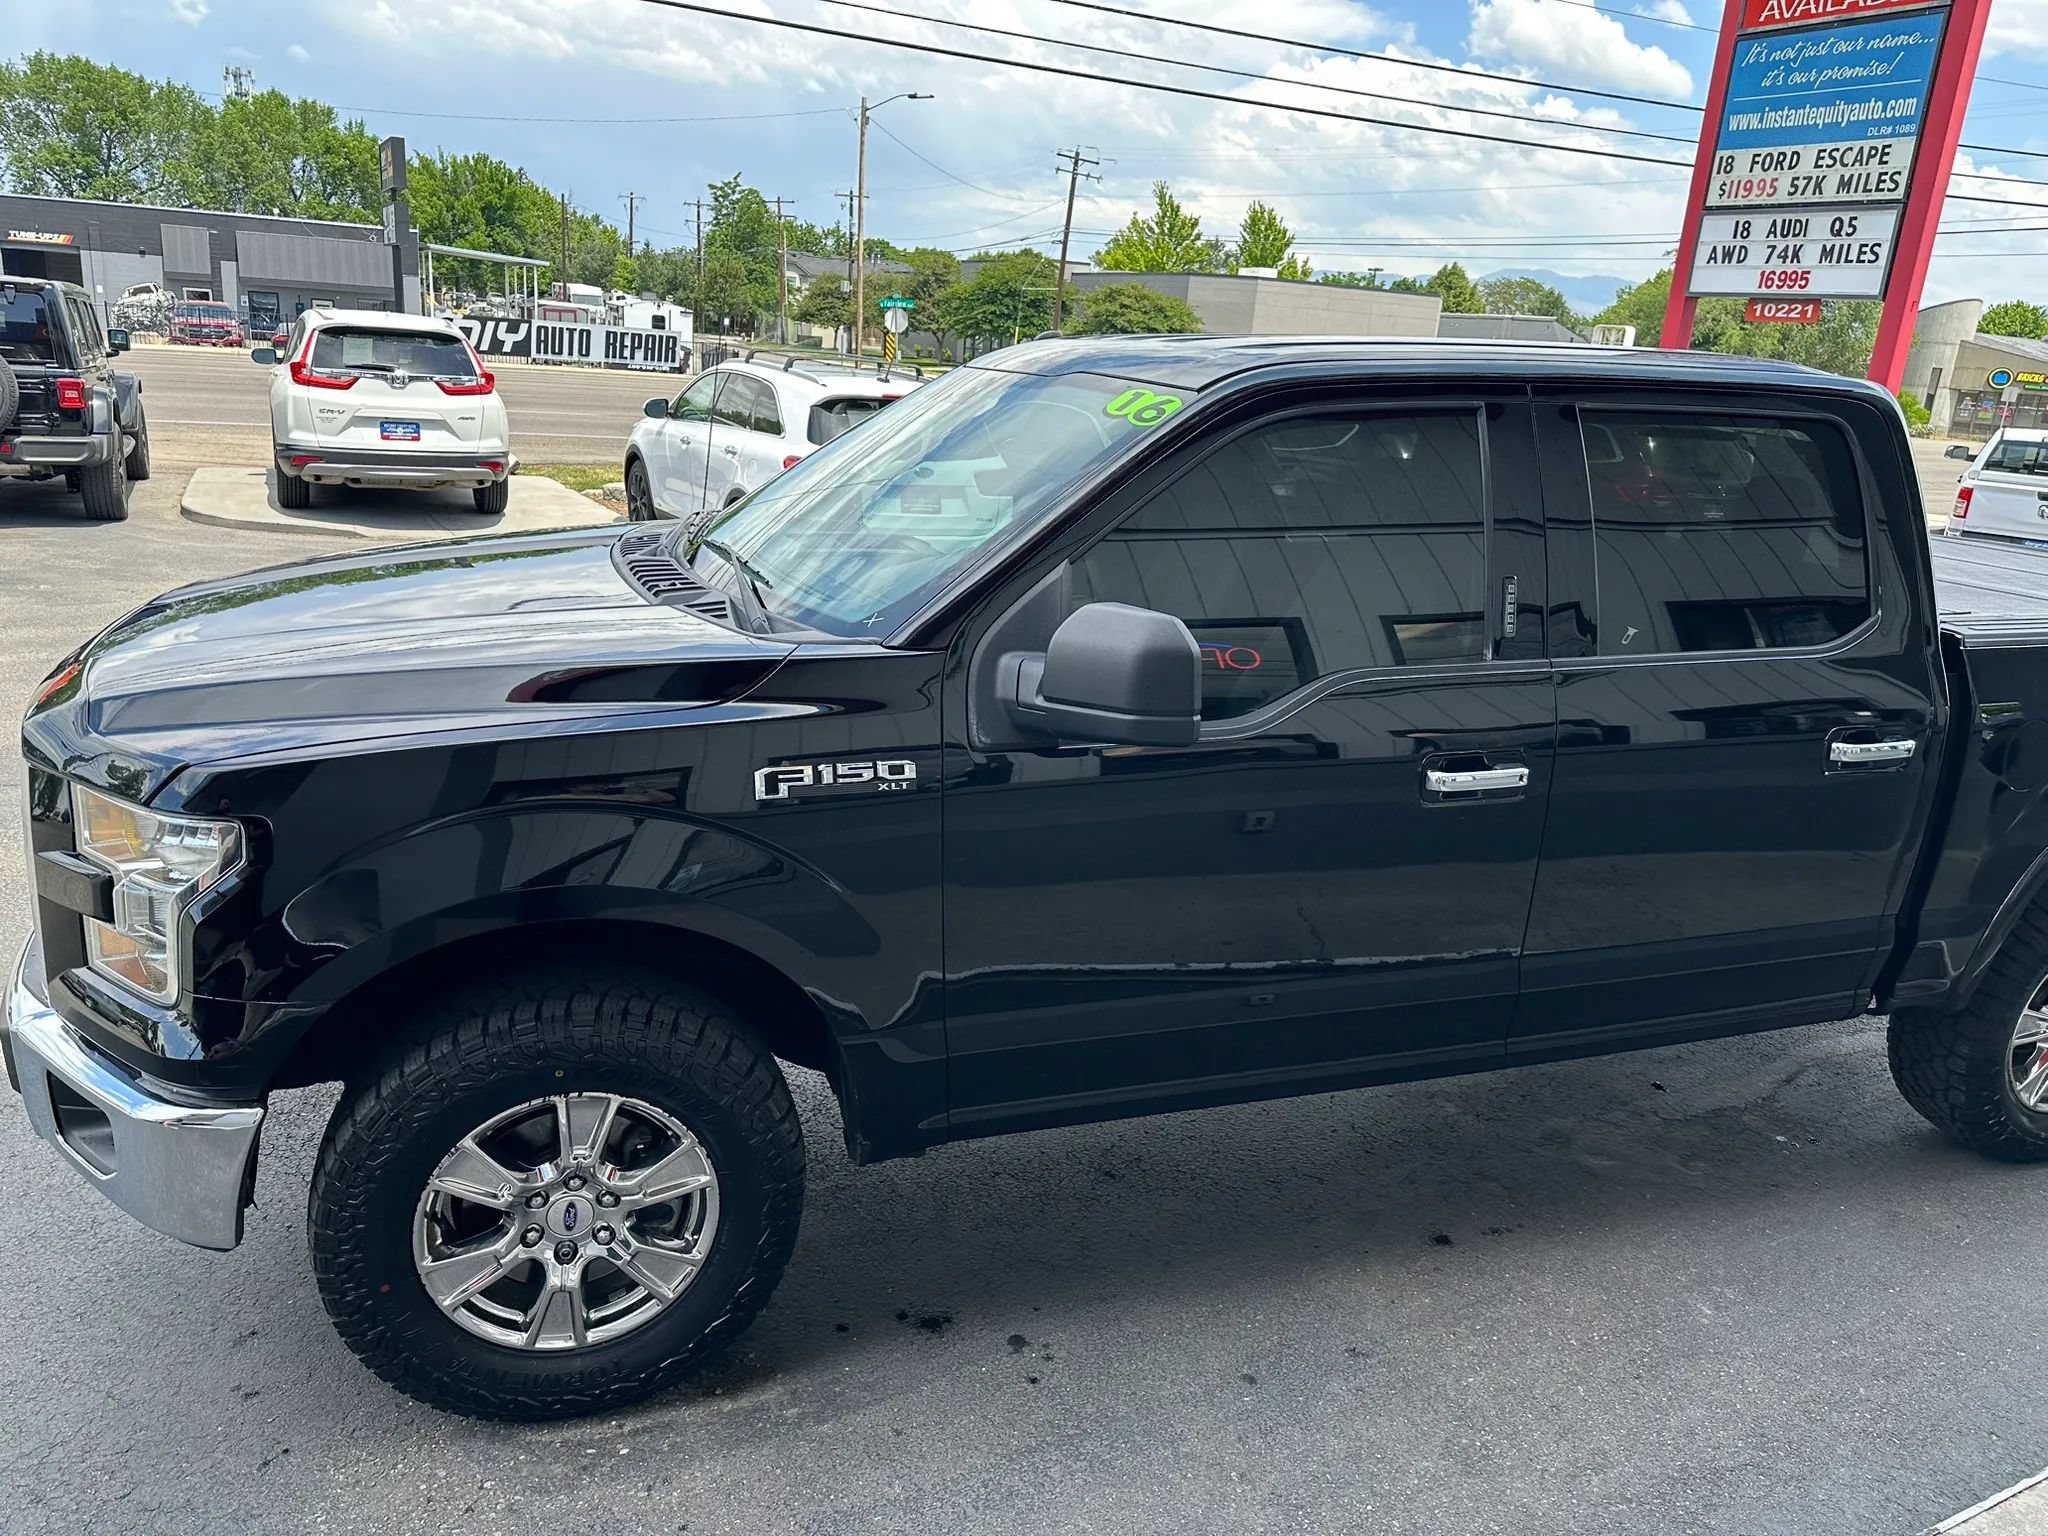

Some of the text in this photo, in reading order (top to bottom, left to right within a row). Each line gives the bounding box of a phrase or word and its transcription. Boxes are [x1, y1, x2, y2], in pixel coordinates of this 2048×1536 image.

[1741, 31, 1935, 67] It's not just our name...
[1761, 52, 1904, 89] it's our promise!
[1728, 97, 1917, 131] www.instantequityauto.com
[1867, 124, 1916, 137] DLR# 1089
[1716, 143, 1892, 175] 18 FORD ESCAPE
[1718, 171, 1902, 200] $11995 57K MILES
[8, 229, 60, 241] TUNE-UPS
[1732, 216, 1858, 240] 18 AUDI Q5
[1706, 242, 1882, 265] AWD 74K MILES
[1757, 269, 1812, 290] 16995
[1752, 302, 1815, 319] 10221
[451, 319, 678, 363] DIY AUTO REPAIR
[2015, 372, 2045, 383] BRICKS
[877, 781, 911, 791] XLT
